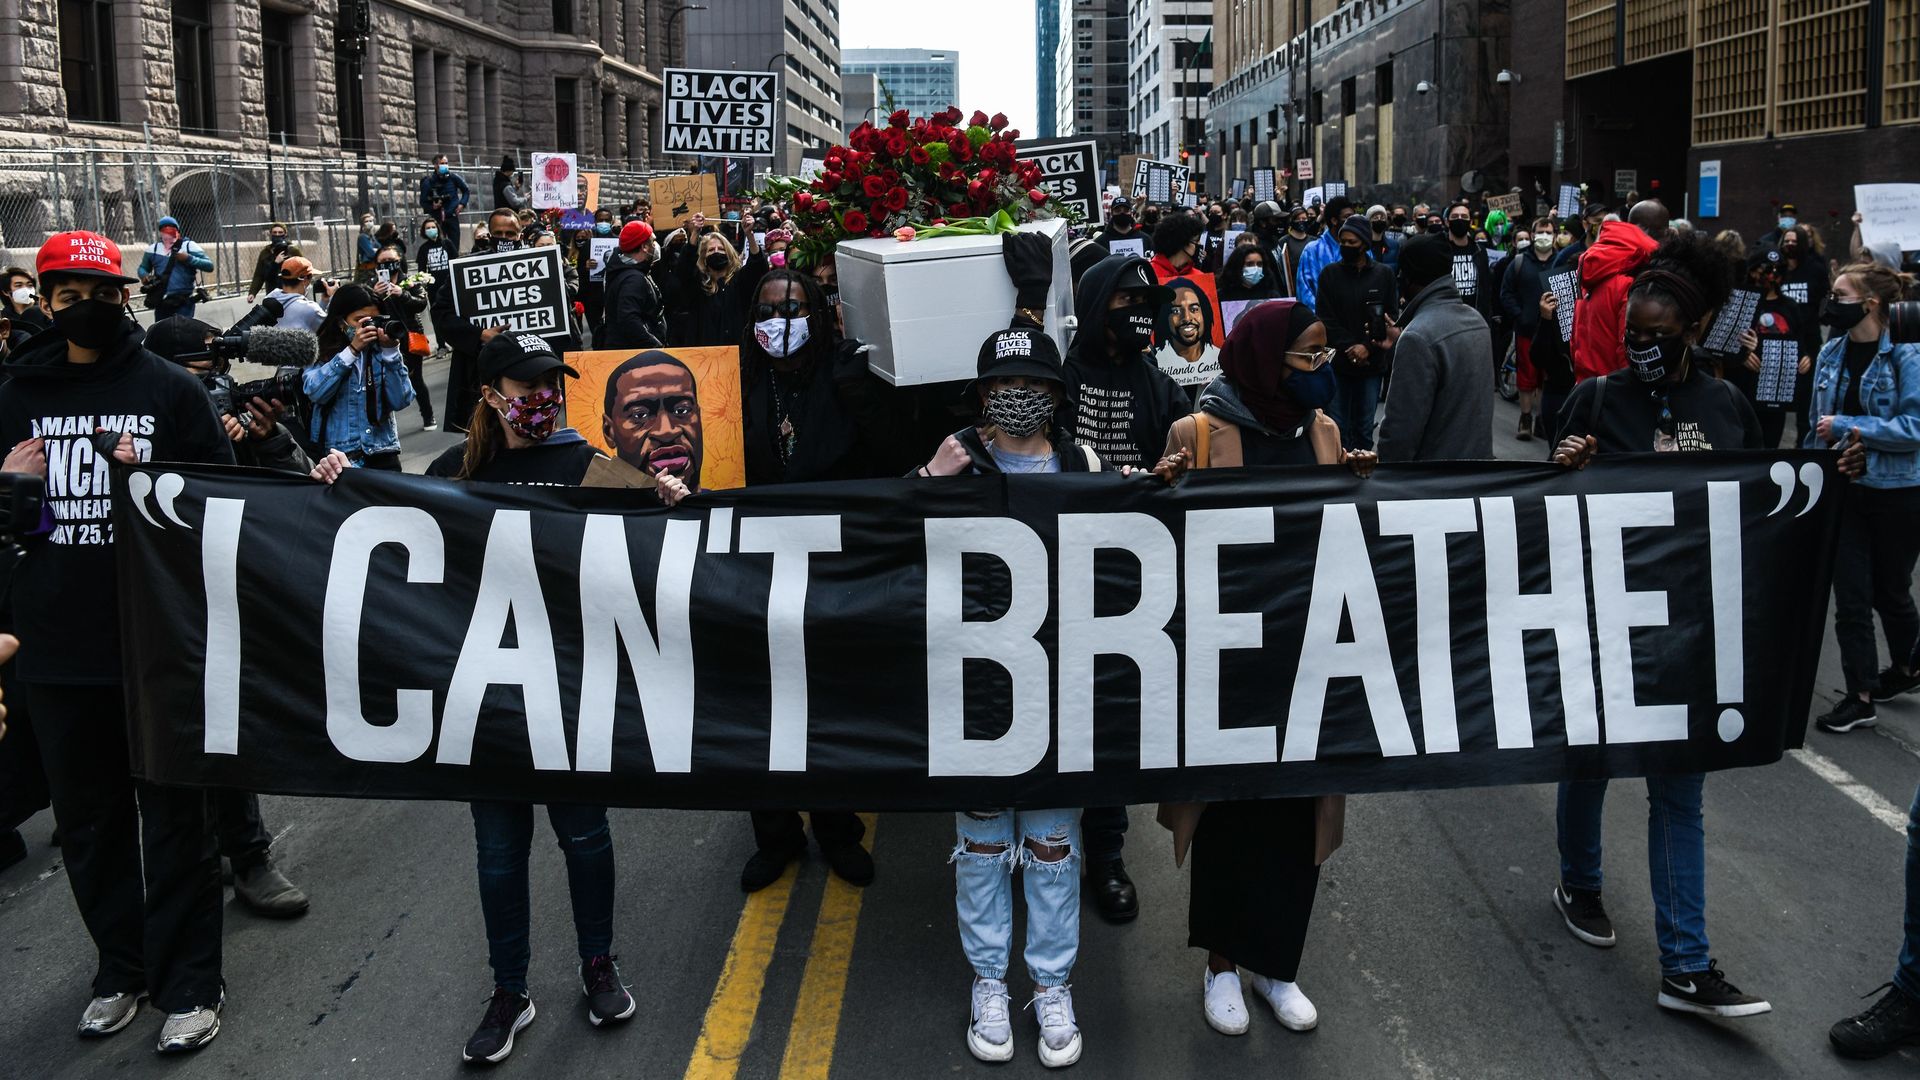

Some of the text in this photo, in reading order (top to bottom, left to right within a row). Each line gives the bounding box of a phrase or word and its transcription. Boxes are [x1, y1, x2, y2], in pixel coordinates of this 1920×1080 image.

[671, 74, 770, 100] BLACK
[676, 101, 764, 126] LIVES
[667, 126, 771, 151] MATTER
[70, 238, 109, 250] BLACK
[79, 246, 104, 256] AND
[70, 254, 111, 266] PROUD
[468, 259, 545, 286] BLACK
[476, 285, 542, 310] LIVES
[473, 310, 552, 330] MATTER
[1130, 316, 1152, 324] BLACK
[998, 332, 1029, 341] BLACK
[999, 340, 1027, 349] LIVES
[996, 349, 1030, 360] MATTER
[1160, 364, 1195, 375] ilando
[42, 416, 94, 436] MAN
[100, 415, 155, 435] WAS
[1681, 422, 1698, 431] CAN'T
[322, 506, 842, 774] CAN'T
